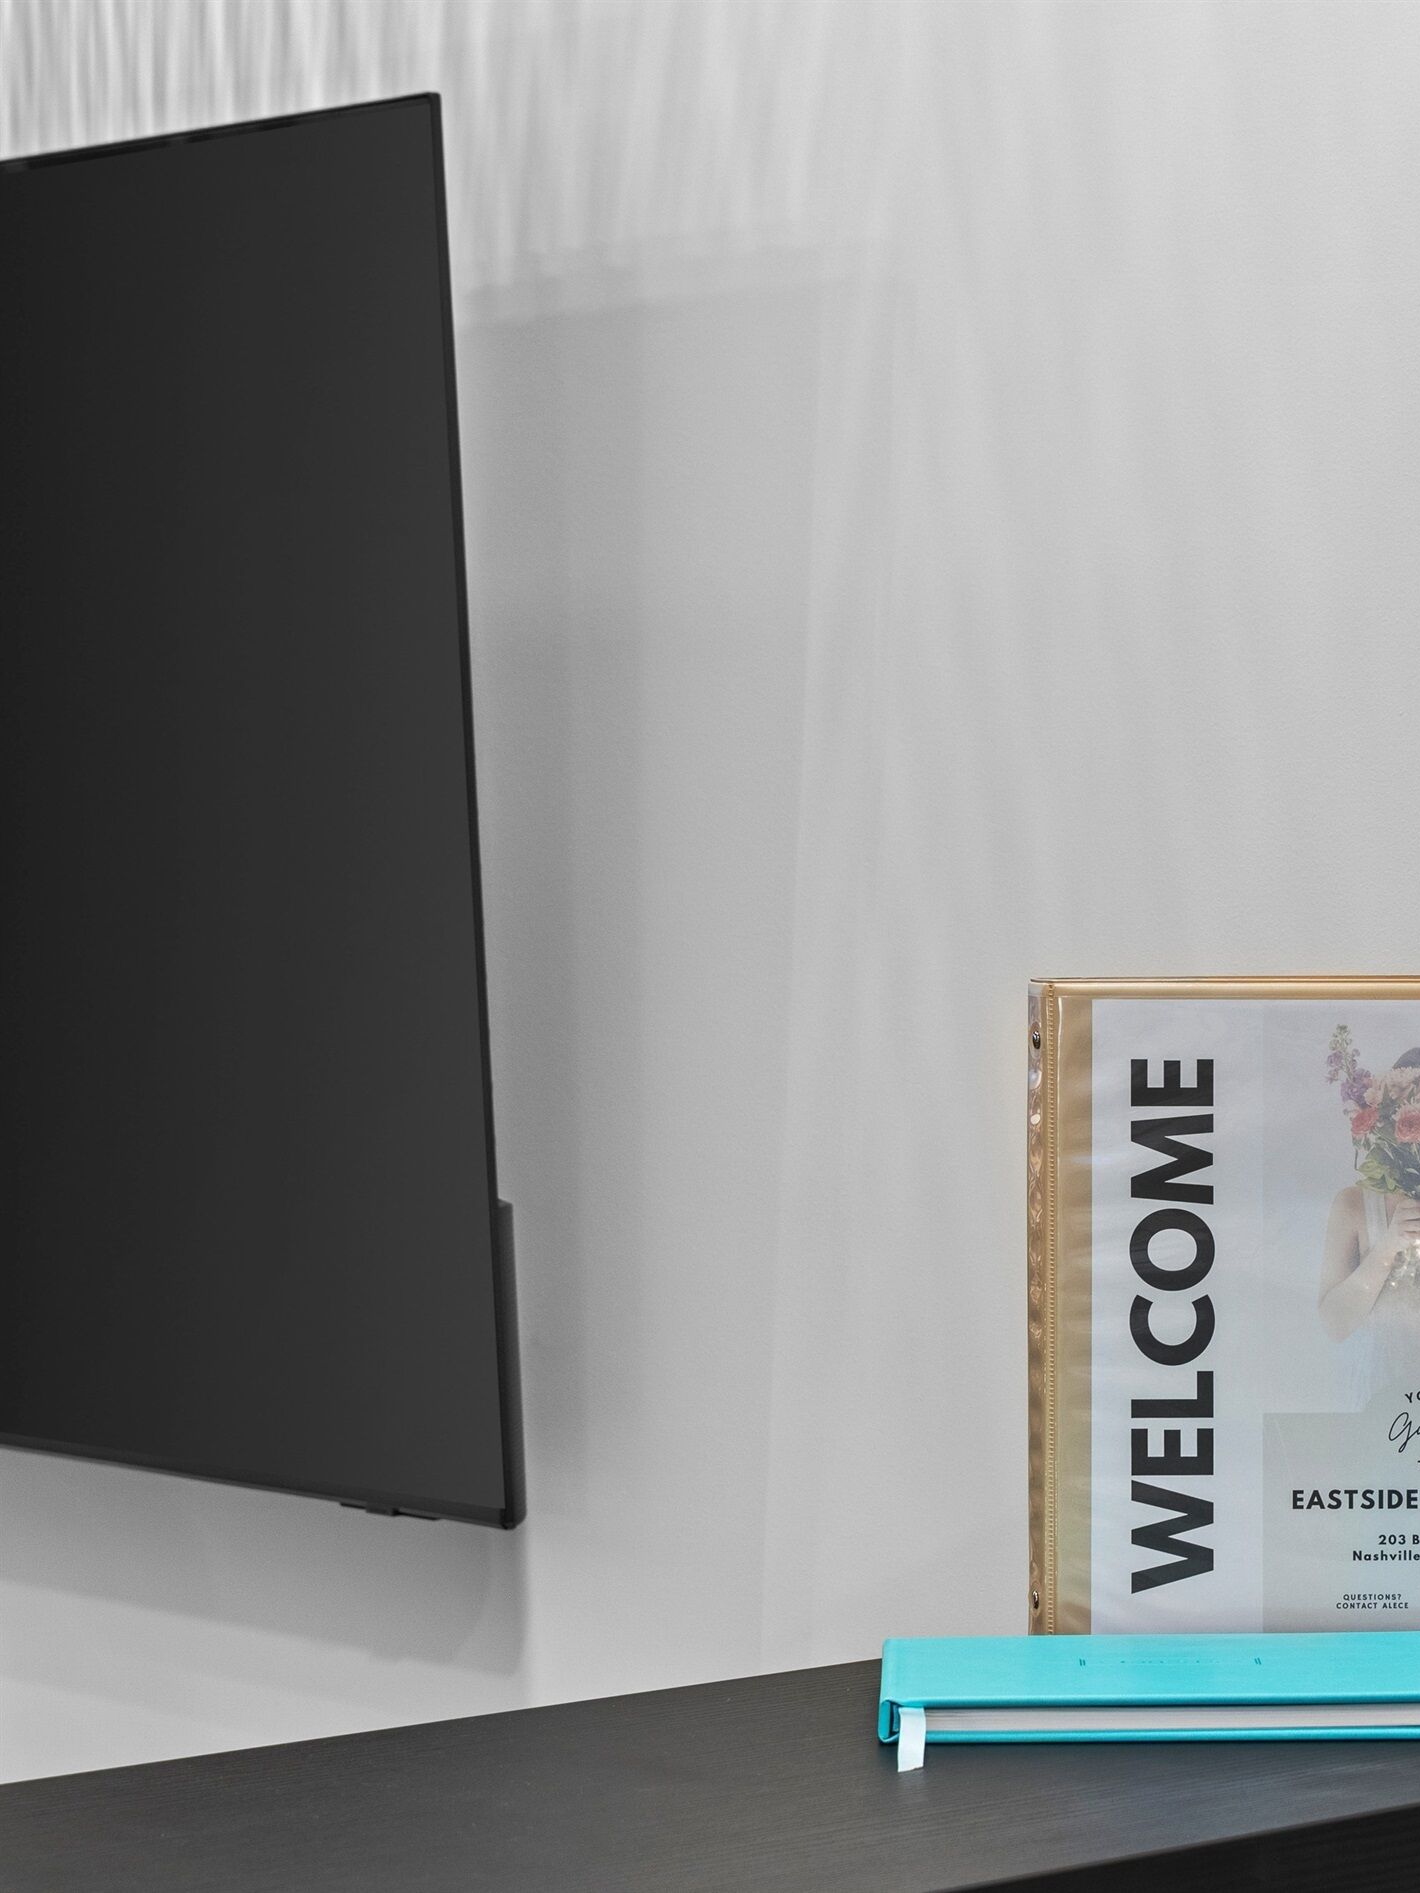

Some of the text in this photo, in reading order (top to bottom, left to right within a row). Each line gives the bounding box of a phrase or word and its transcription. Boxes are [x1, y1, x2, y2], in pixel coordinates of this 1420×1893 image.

[1129, 1059, 1215, 1594] WELCOME
[1291, 1488, 1419, 1510] EASTSIDE
[1378, 1533, 1407, 1546] 203
[1411, 1533, 1420, 1546] B
[1342, 1592, 1402, 1602] QUESTIONS?
[1335, 1601, 1409, 1610] CONTACT ALECE
